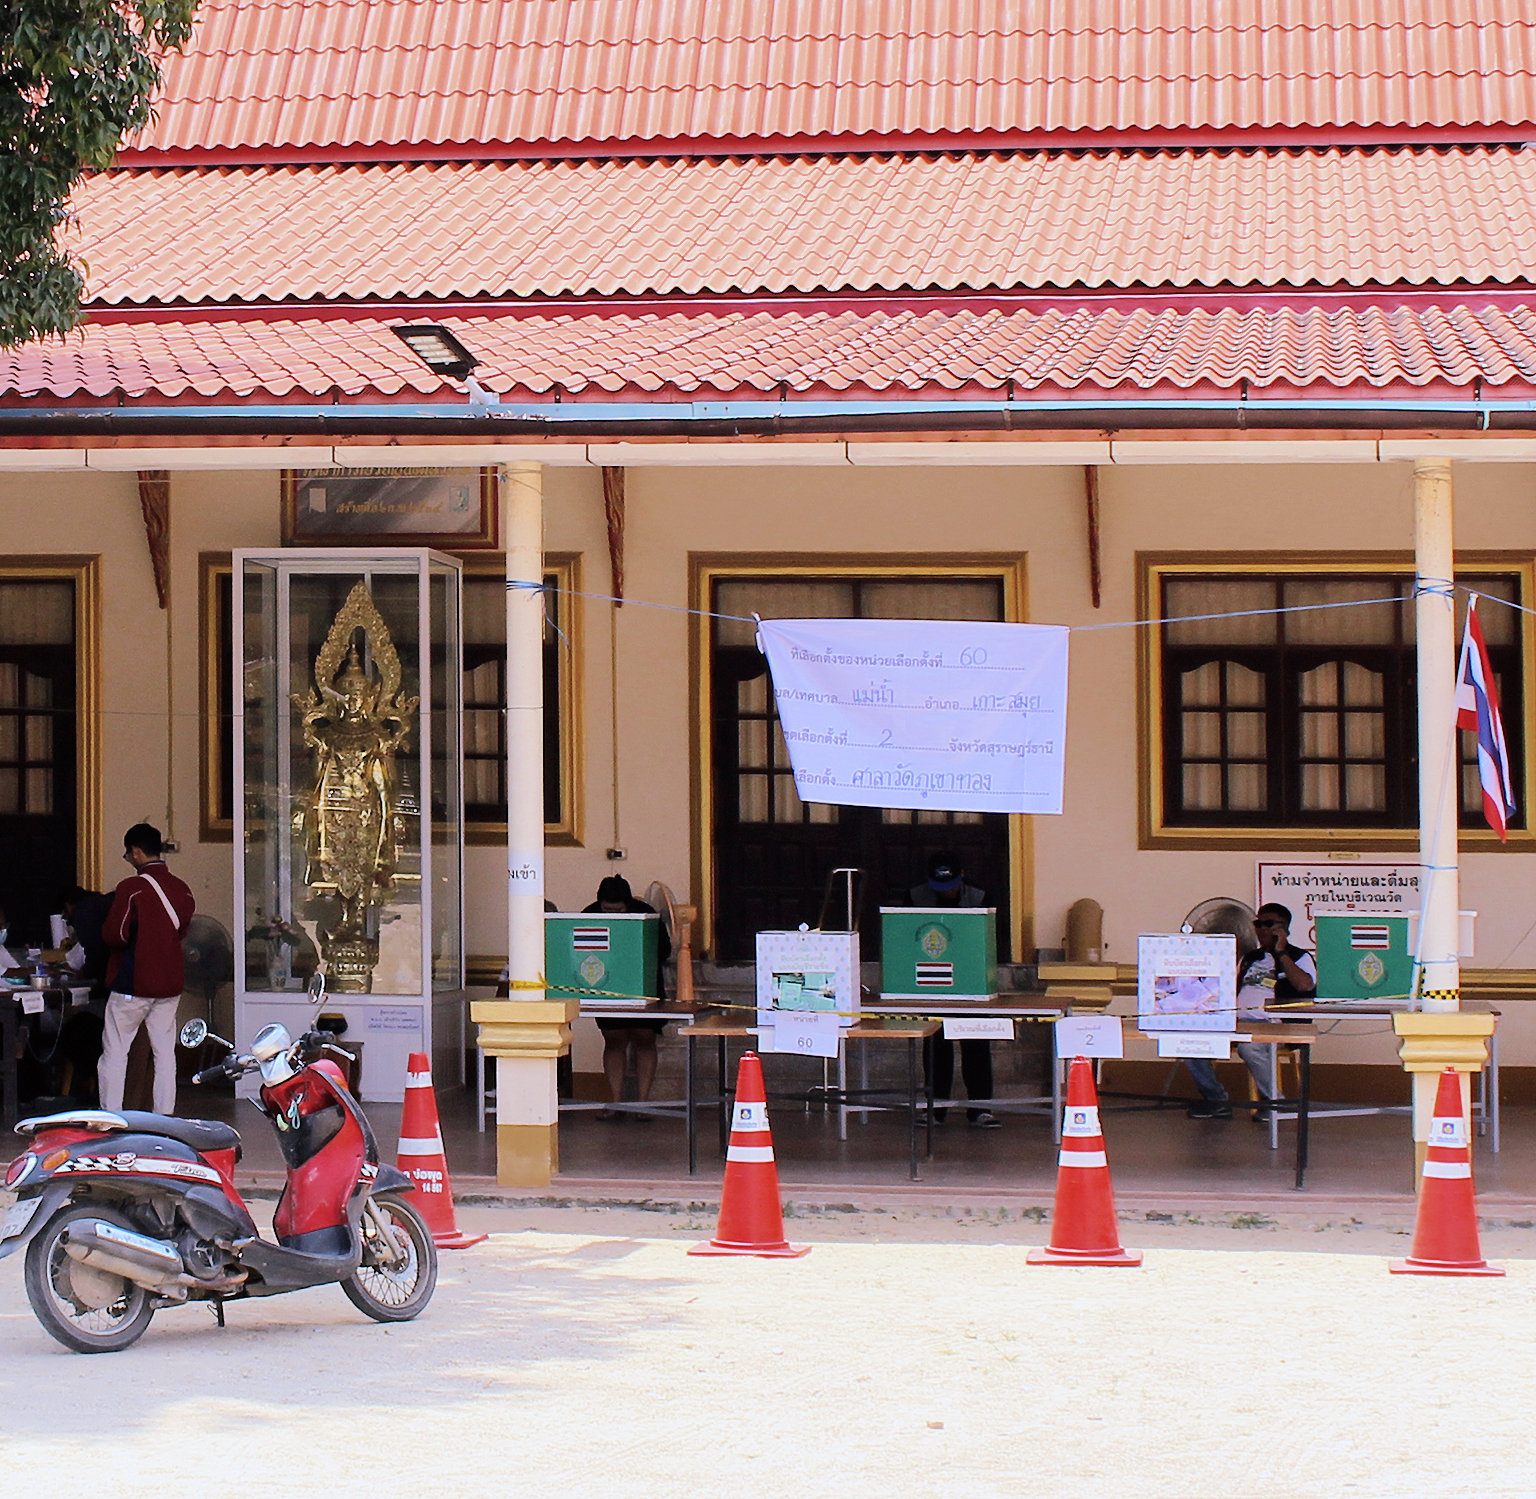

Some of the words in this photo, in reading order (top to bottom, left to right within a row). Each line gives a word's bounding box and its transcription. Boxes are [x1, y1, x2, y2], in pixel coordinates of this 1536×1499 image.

[959, 646, 988, 666] 60
[924, 696, 960, 711] อำเภอ
[878, 728, 894, 748] 2
[949, 738, 1054, 758] จังหวัดสุราษฎร์ธานี
[1305, 890, 1402, 903] ภายในบริเวณวัด
[797, 1037, 813, 1048] 60
[1085, 1034, 1094, 1046] 2
